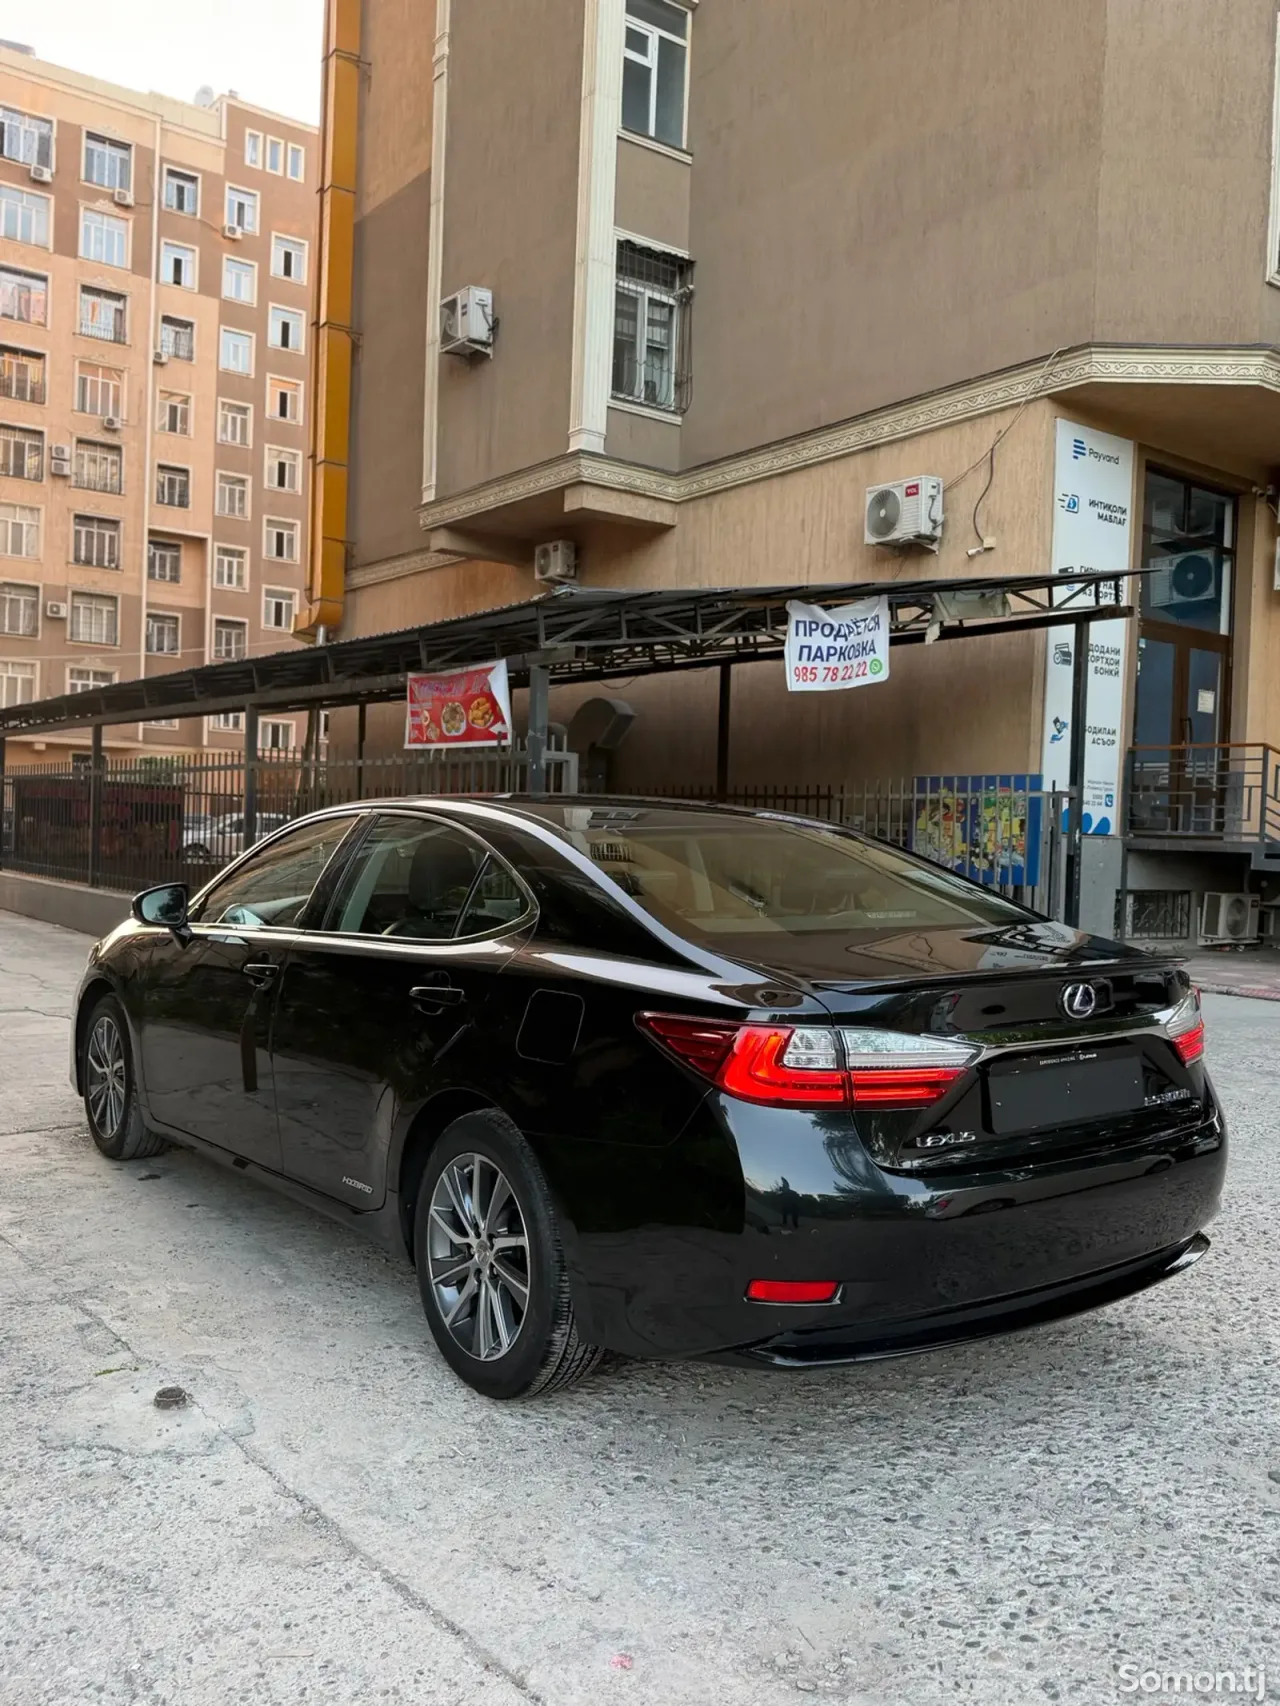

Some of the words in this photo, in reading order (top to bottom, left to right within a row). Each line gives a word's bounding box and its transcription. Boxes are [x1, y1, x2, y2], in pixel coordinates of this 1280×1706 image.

[1088, 448, 1119, 465] Payvand
[798, 639, 876, 662] ПАРКОВКА
[1088, 655, 1120, 667] ОРТҲОИ
[794, 666, 818, 683] 985
[822, 666, 839, 683] 78
[1086, 725, 1116, 736] ОДИЛАИ
[916, 1131, 976, 1148] LEXUS
[342, 1176, 373, 1194] HYBRID
